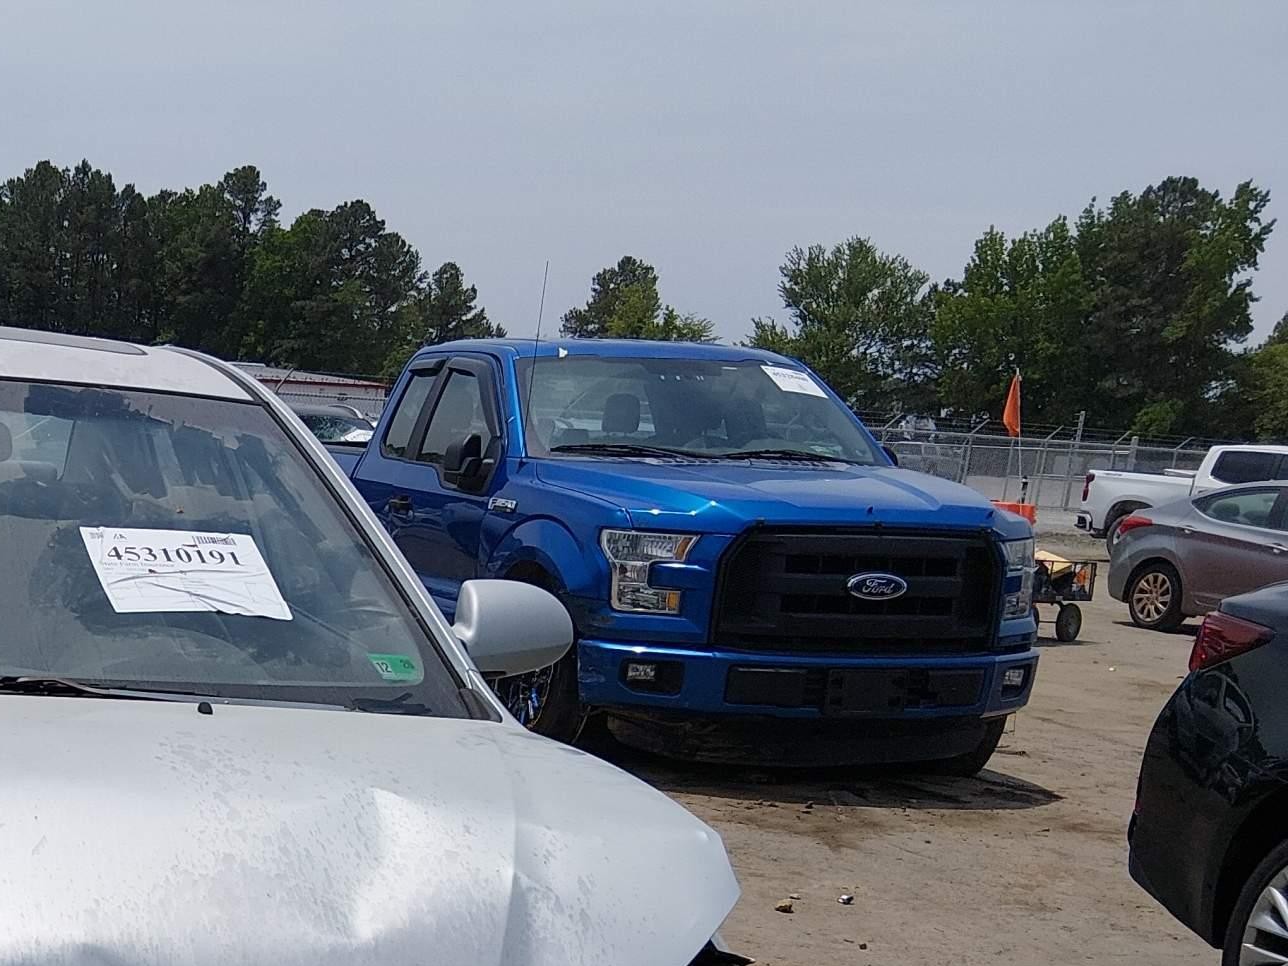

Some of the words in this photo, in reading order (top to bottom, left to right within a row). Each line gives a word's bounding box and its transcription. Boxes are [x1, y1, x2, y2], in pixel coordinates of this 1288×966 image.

[107, 546, 244, 566] 45310191
[862, 579, 895, 594] Ford
[375, 661, 393, 673] 12
